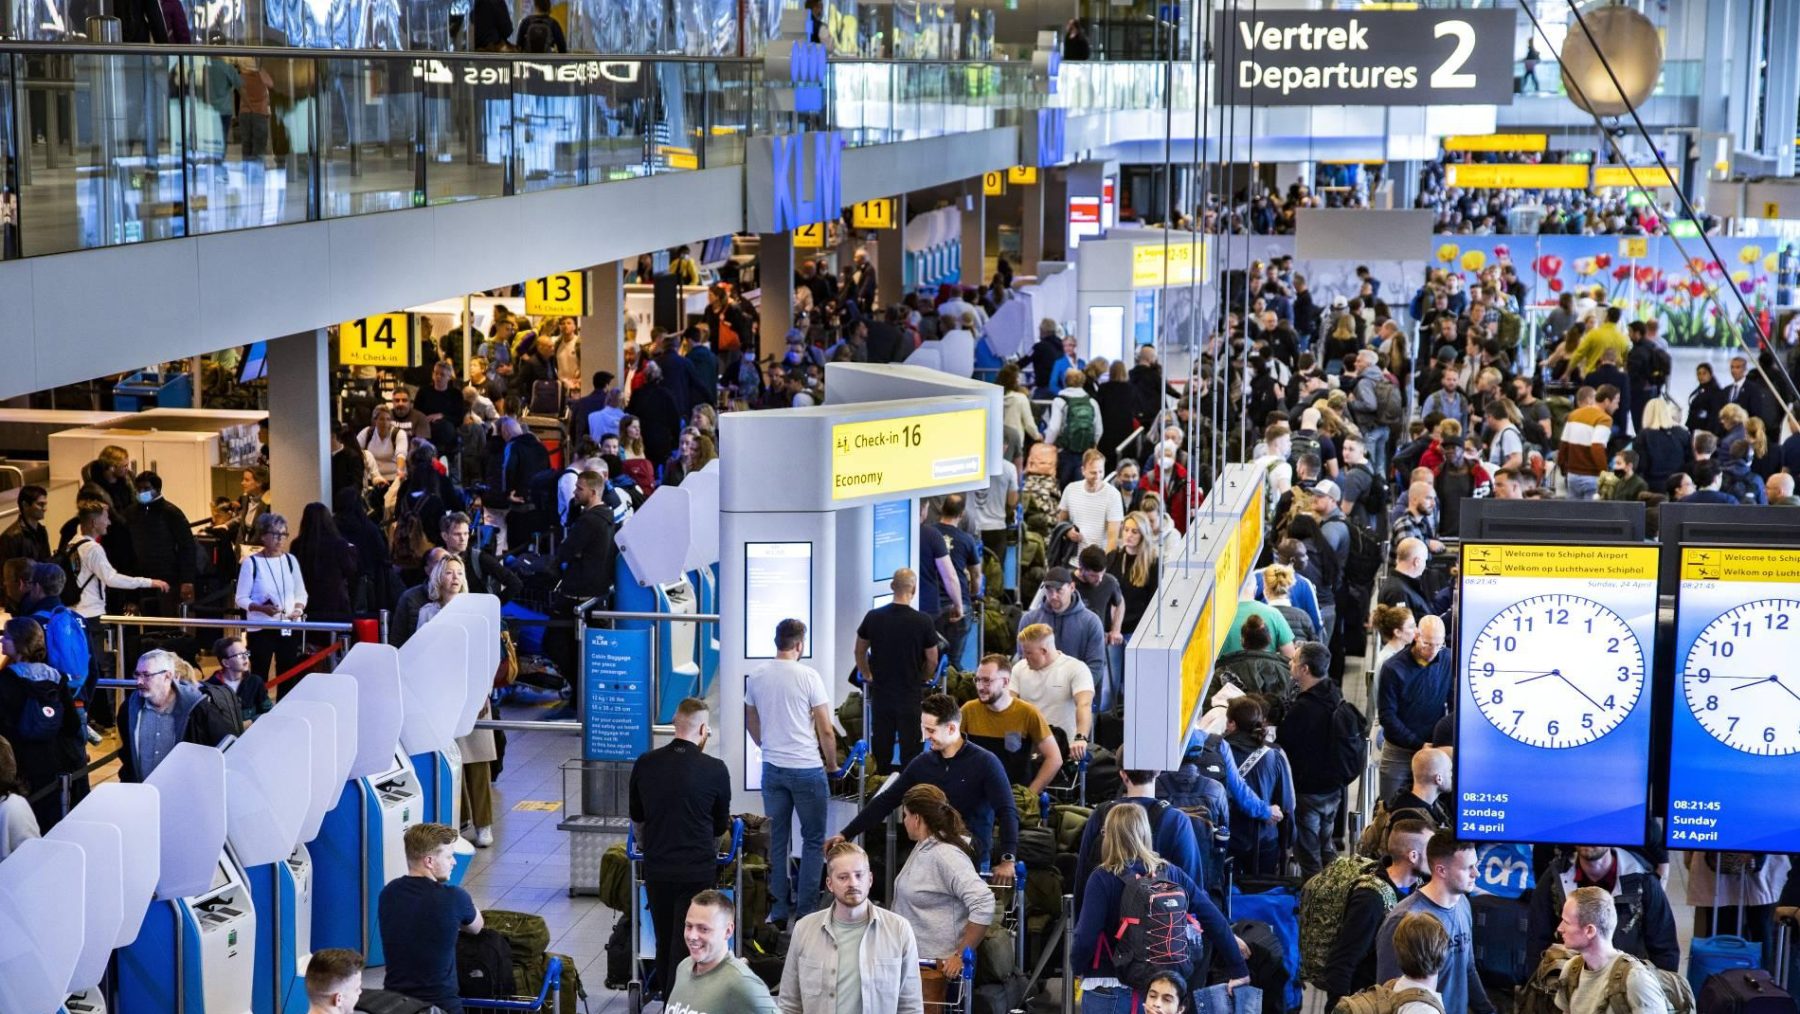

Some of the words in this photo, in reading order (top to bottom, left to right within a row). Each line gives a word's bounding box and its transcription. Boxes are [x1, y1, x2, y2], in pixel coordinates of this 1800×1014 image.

[1239, 19, 1369, 50] Vertrek
[1430, 20, 1476, 88] 2
[1239, 60, 1418, 95] Departures
[773, 131, 842, 233] KLM
[986, 172, 997, 188] 0
[860, 201, 884, 219] 11
[536, 276, 572, 302] 13
[353, 318, 397, 350] 14
[363, 353, 399, 362] Check-in
[855, 431, 899, 448] Check-in
[902, 424, 922, 448] 16
[835, 472, 883, 488] Economy
[1504, 550, 1544, 558] Welcome
[1558, 550, 1595, 560] Schiphol
[1597, 552, 1628, 560] Airport
[1504, 564, 1540, 572] Welkom
[1555, 565, 1605, 574] Luchthaven
[1607, 566, 1644, 575] Schiphol
[1588, 580, 1618, 588] Sunday,
[1636, 581, 1652, 589] April
[1514, 616, 1533, 632] 11
[1545, 609, 1569, 624] 12
[1764, 614, 1789, 630] 12
[1584, 618, 1592, 634] 1
[1731, 621, 1752, 638] 11
[1492, 636, 1516, 652] 10
[1607, 638, 1620, 653] 2
[1709, 640, 1734, 658] 10
[1482, 662, 1495, 678] 9
[1617, 666, 1630, 682] 3
[1698, 668, 1710, 684] 9
[1492, 689, 1504, 704] 8
[1604, 694, 1616, 710] 4
[1706, 695, 1718, 711] 8
[1512, 710, 1524, 725] 7
[1581, 713, 1594, 728] 5
[1728, 716, 1740, 732] 7
[1548, 720, 1560, 736] 6
[1764, 726, 1776, 742] 6
[1463, 792, 1508, 802] 08:21:45
[1463, 808, 1505, 819] zondag
[1674, 800, 1720, 811] 08:21:45
[1462, 822, 1476, 832] 24
[1478, 822, 1504, 833] april
[1673, 815, 1717, 828] Sunday
[1672, 830, 1686, 840] 24
[1688, 831, 1718, 842] April
